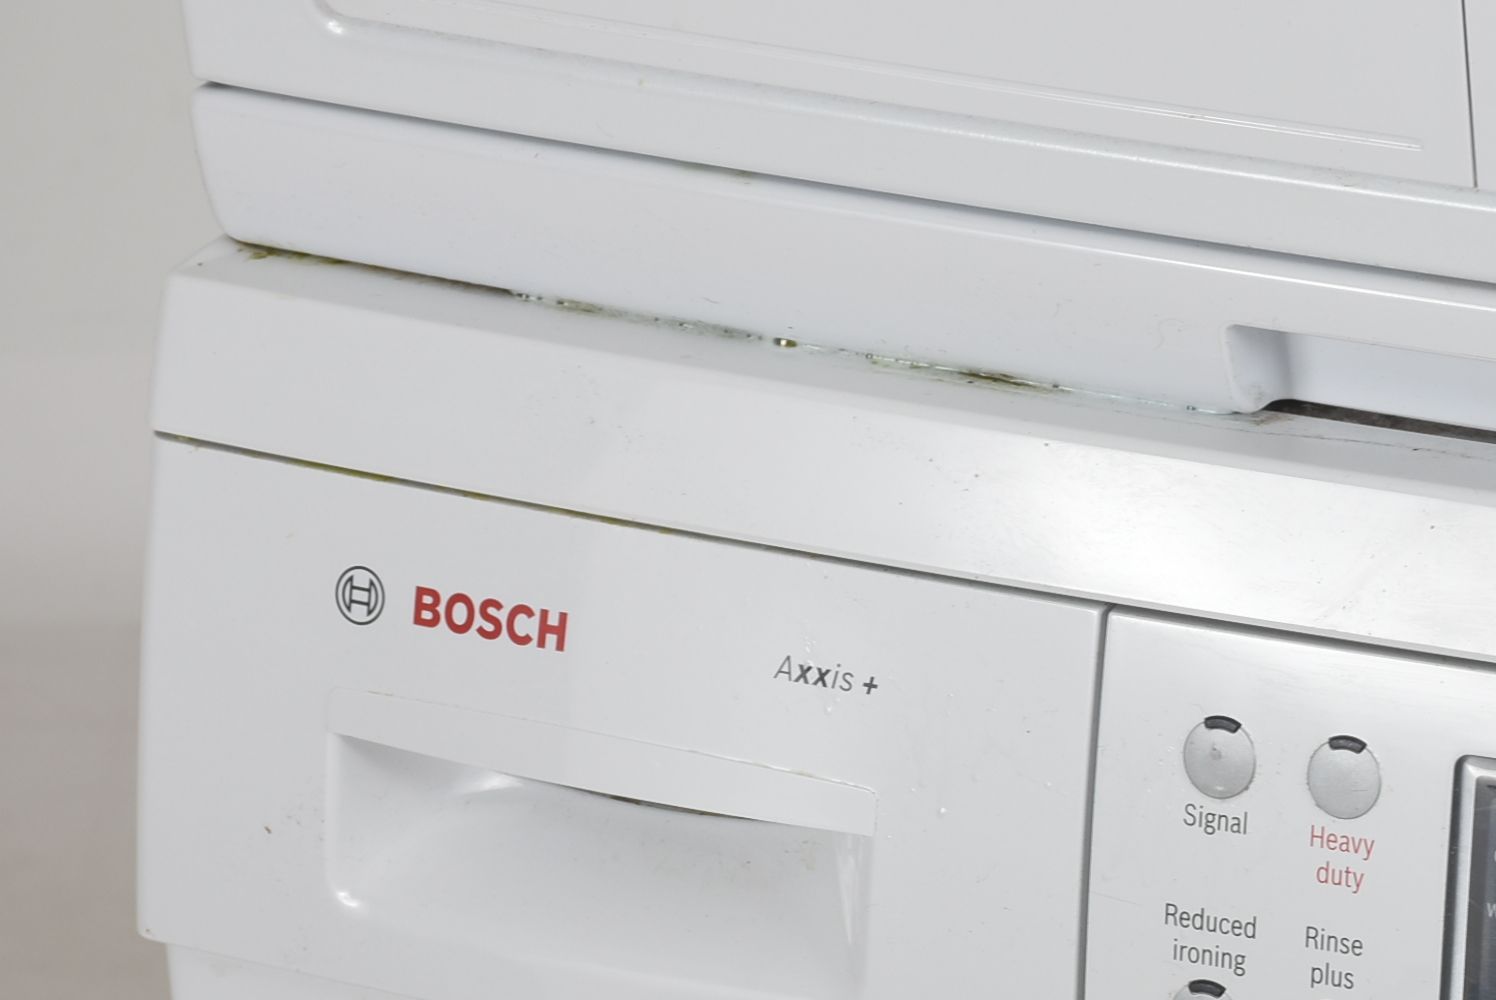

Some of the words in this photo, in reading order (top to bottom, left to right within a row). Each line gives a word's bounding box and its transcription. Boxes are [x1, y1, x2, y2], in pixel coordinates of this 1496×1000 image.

[412, 585, 568, 652] BOSCH
[773, 655, 854, 692] Axxis
[1182, 803, 1248, 835] Signal
[1310, 825, 1375, 860] Heavy
[1316, 862, 1364, 894] duty
[1164, 903, 1256, 939] Reduced
[1173, 939, 1246, 977] ironing
[1305, 926, 1363, 956] Rinse
[1310, 962, 1354, 989] plus
